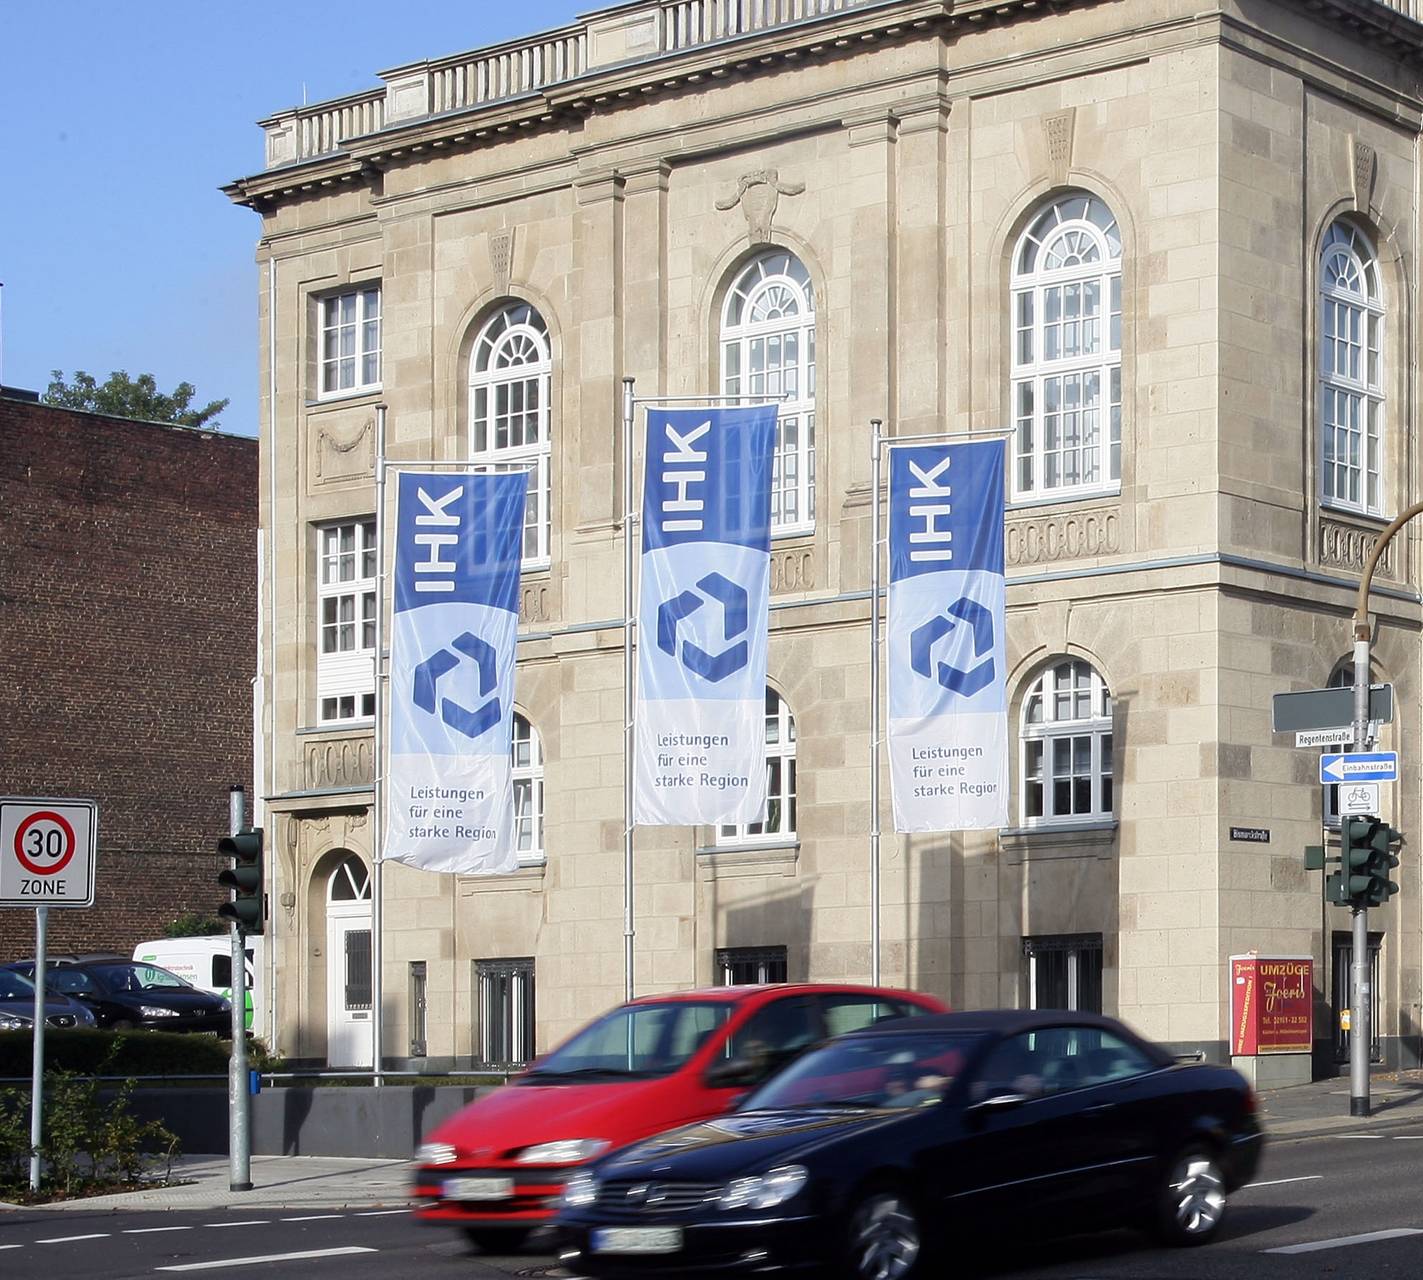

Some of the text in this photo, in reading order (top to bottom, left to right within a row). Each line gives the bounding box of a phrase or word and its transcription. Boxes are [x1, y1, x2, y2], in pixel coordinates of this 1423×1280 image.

[662, 420, 711, 532] IHK
[909, 456, 952, 562] IHK
[414, 485, 464, 592] IHK
[657, 732, 729, 749] Leistungen
[1299, 731, 1350, 746] Regentenstraße
[657, 753, 708, 767] für eine
[912, 746, 983, 760] Leistungen
[912, 764, 965, 778] für eine
[1342, 763, 1393, 771] Einbahnstraße
[655, 772, 748, 790] starke Region
[410, 785, 484, 803] Leistungen
[914, 784, 954, 797] starke
[409, 805, 463, 819] für eine
[409, 825, 496, 842] starke Region
[27, 828, 63, 858] 30
[20, 879, 66, 895] ZONE
[1260, 962, 1310, 976] UMZÜGE
